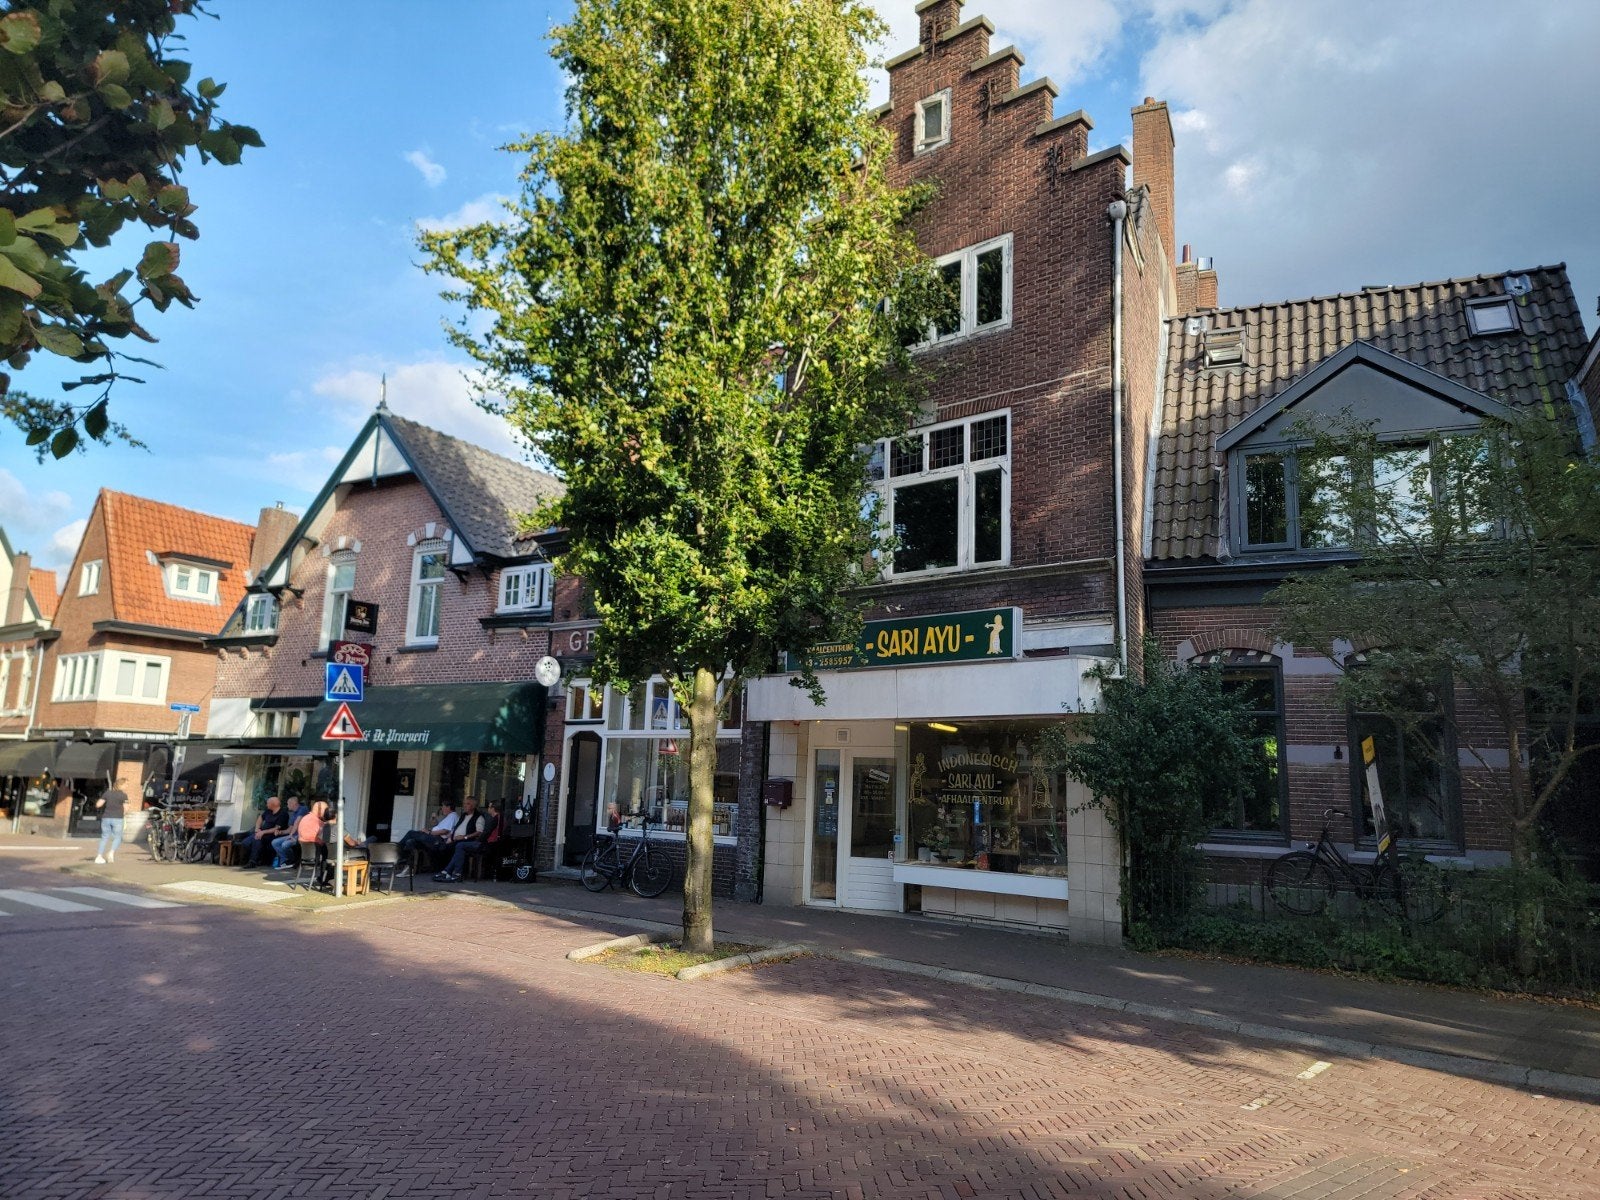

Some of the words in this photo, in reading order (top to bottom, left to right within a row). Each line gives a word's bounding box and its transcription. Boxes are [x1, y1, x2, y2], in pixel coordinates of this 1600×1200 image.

[877, 628, 919, 658] SARI
[923, 623, 961, 655] AYU
[937, 752, 1019, 774] INDONESISCH
[948, 773, 972, 790] SARI
[974, 773, 995, 790] AYU
